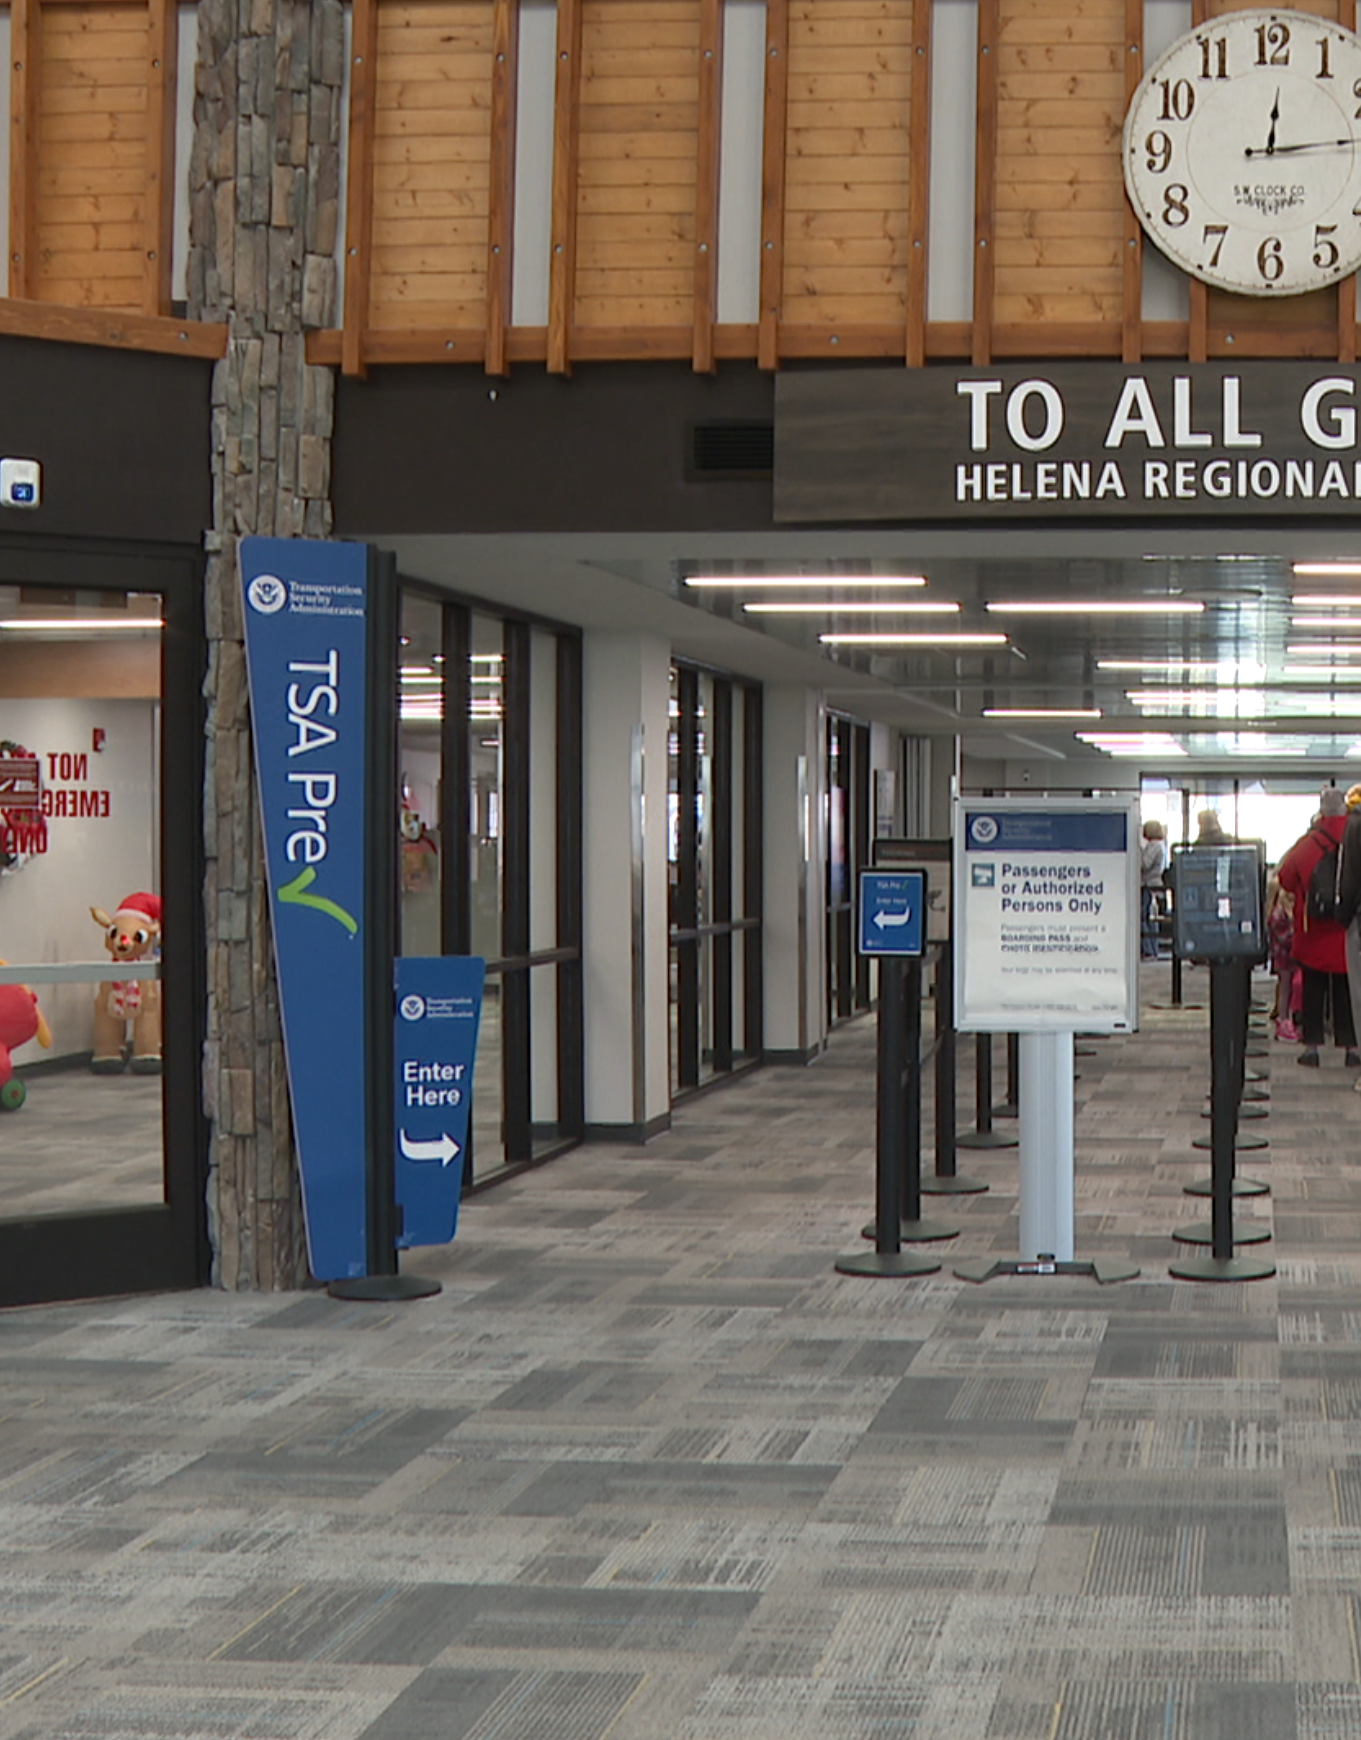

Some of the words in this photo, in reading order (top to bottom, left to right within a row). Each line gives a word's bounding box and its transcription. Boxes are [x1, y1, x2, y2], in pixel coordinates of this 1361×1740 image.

[1198, 37, 1230, 80] 11
[1254, 23, 1291, 66] 12
[1315, 37, 1334, 79] 1
[1156, 78, 1195, 120] 10
[1145, 130, 1172, 173] 9
[1161, 183, 1190, 227] 8
[1254, 185, 1286, 196] CLOCK
[1203, 225, 1229, 268] 7
[1257, 237, 1284, 281] 6
[1313, 224, 1339, 268] 5
[956, 379, 1064, 451] TO
[1104, 376, 1262, 448] ALL
[956, 461, 1126, 501] HELENA
[289, 581, 363, 596] Transportation
[289, 593, 331, 606] Security
[289, 604, 365, 617] Administration
[288, 649, 338, 757] TSA
[286, 773, 338, 863] Pre
[1001, 883, 1016, 895] or
[1021, 881, 1103, 895] Authorized
[1002, 863, 1090, 880] Passengers
[1001, 899, 1063, 912] Persons
[1068, 899, 1102, 915] Only
[403, 1061, 464, 1083] Enter
[406, 1085, 461, 1107] Here
